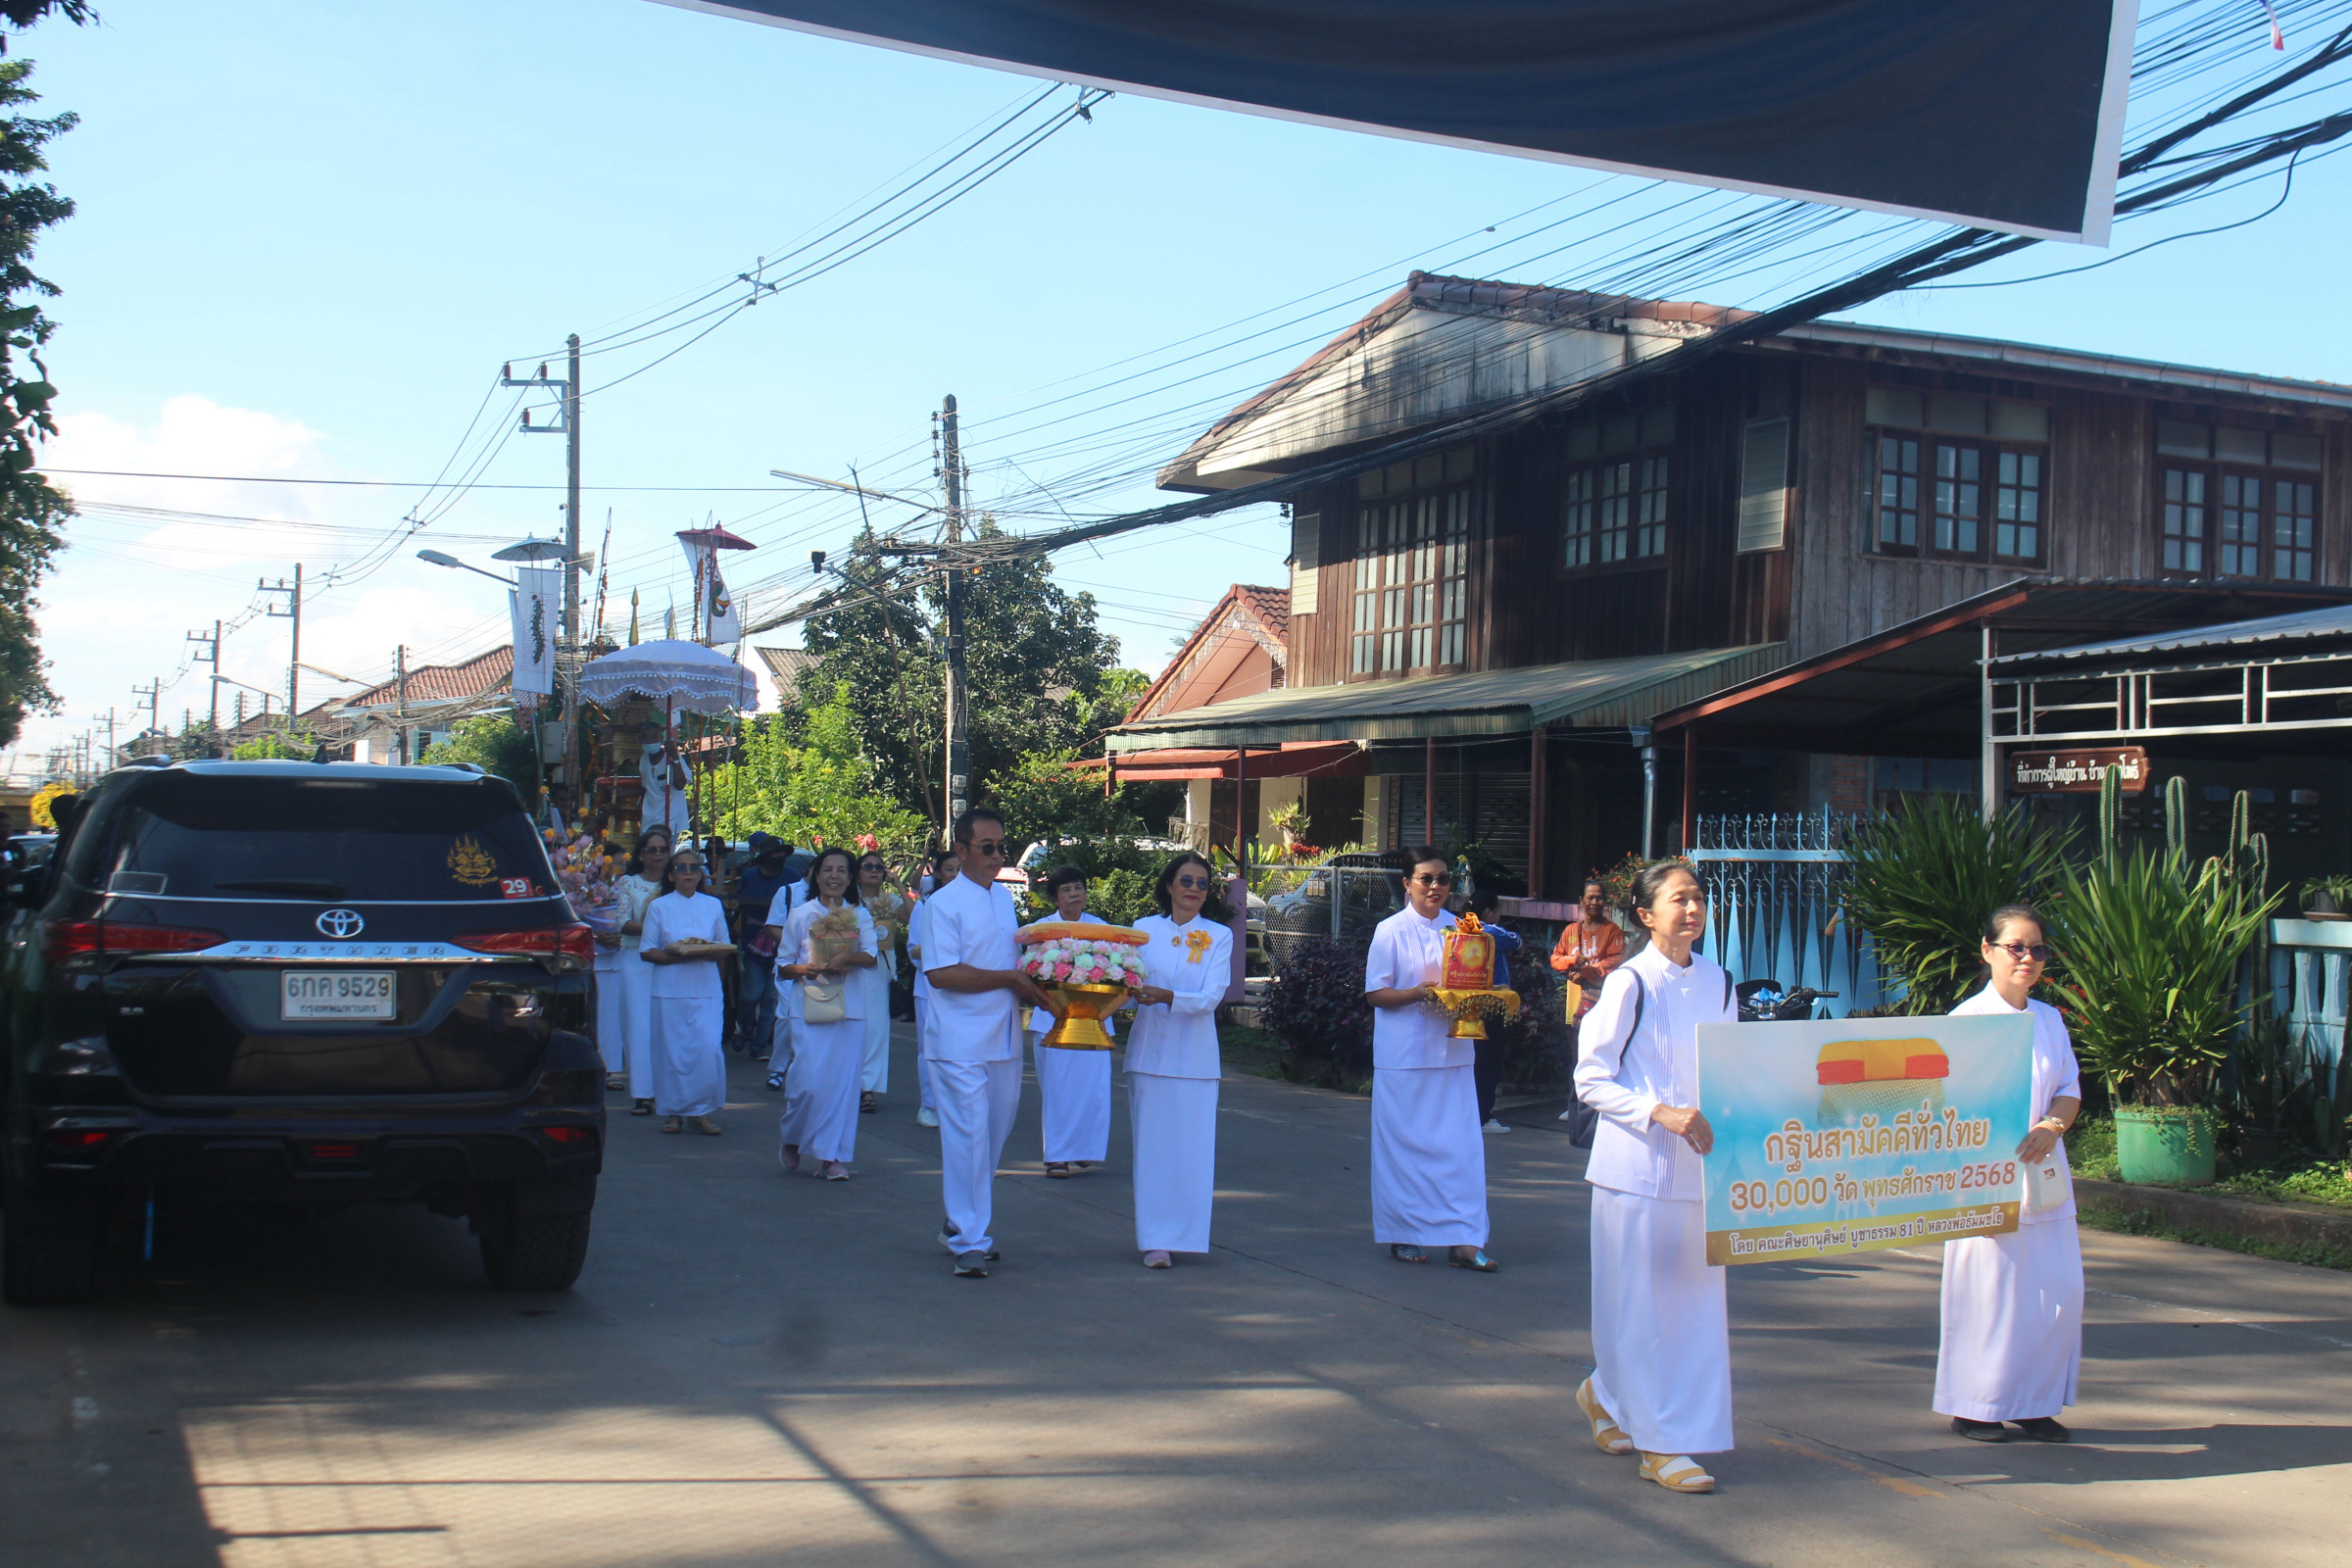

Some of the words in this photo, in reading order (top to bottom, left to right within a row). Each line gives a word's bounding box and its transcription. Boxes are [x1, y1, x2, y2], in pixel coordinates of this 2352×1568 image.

[503, 879, 527, 895] 29
[234, 945, 445, 956] FORTUNER
[338, 977, 390, 997] 9529
[1766, 1102, 1989, 1172] กฐินสามัคคีทั่วไทย
[1732, 1177, 1827, 1214] 30,000
[1834, 1172, 1858, 1201] วัด
[1863, 1168, 1956, 1207] พุทธศักราช
[1960, 1161, 2016, 1189] 2568
[1731, 1236, 1753, 1254] โดย
[1759, 1226, 1847, 1253] คณะศิษยานุศิษย์
[1850, 1227, 1896, 1248] บูชาธรรม
[1899, 1224, 1913, 1237] 81
[1917, 1218, 1925, 1235] ปี
[1928, 1208, 2003, 1234] หลวงพ่อธัมมชโย
